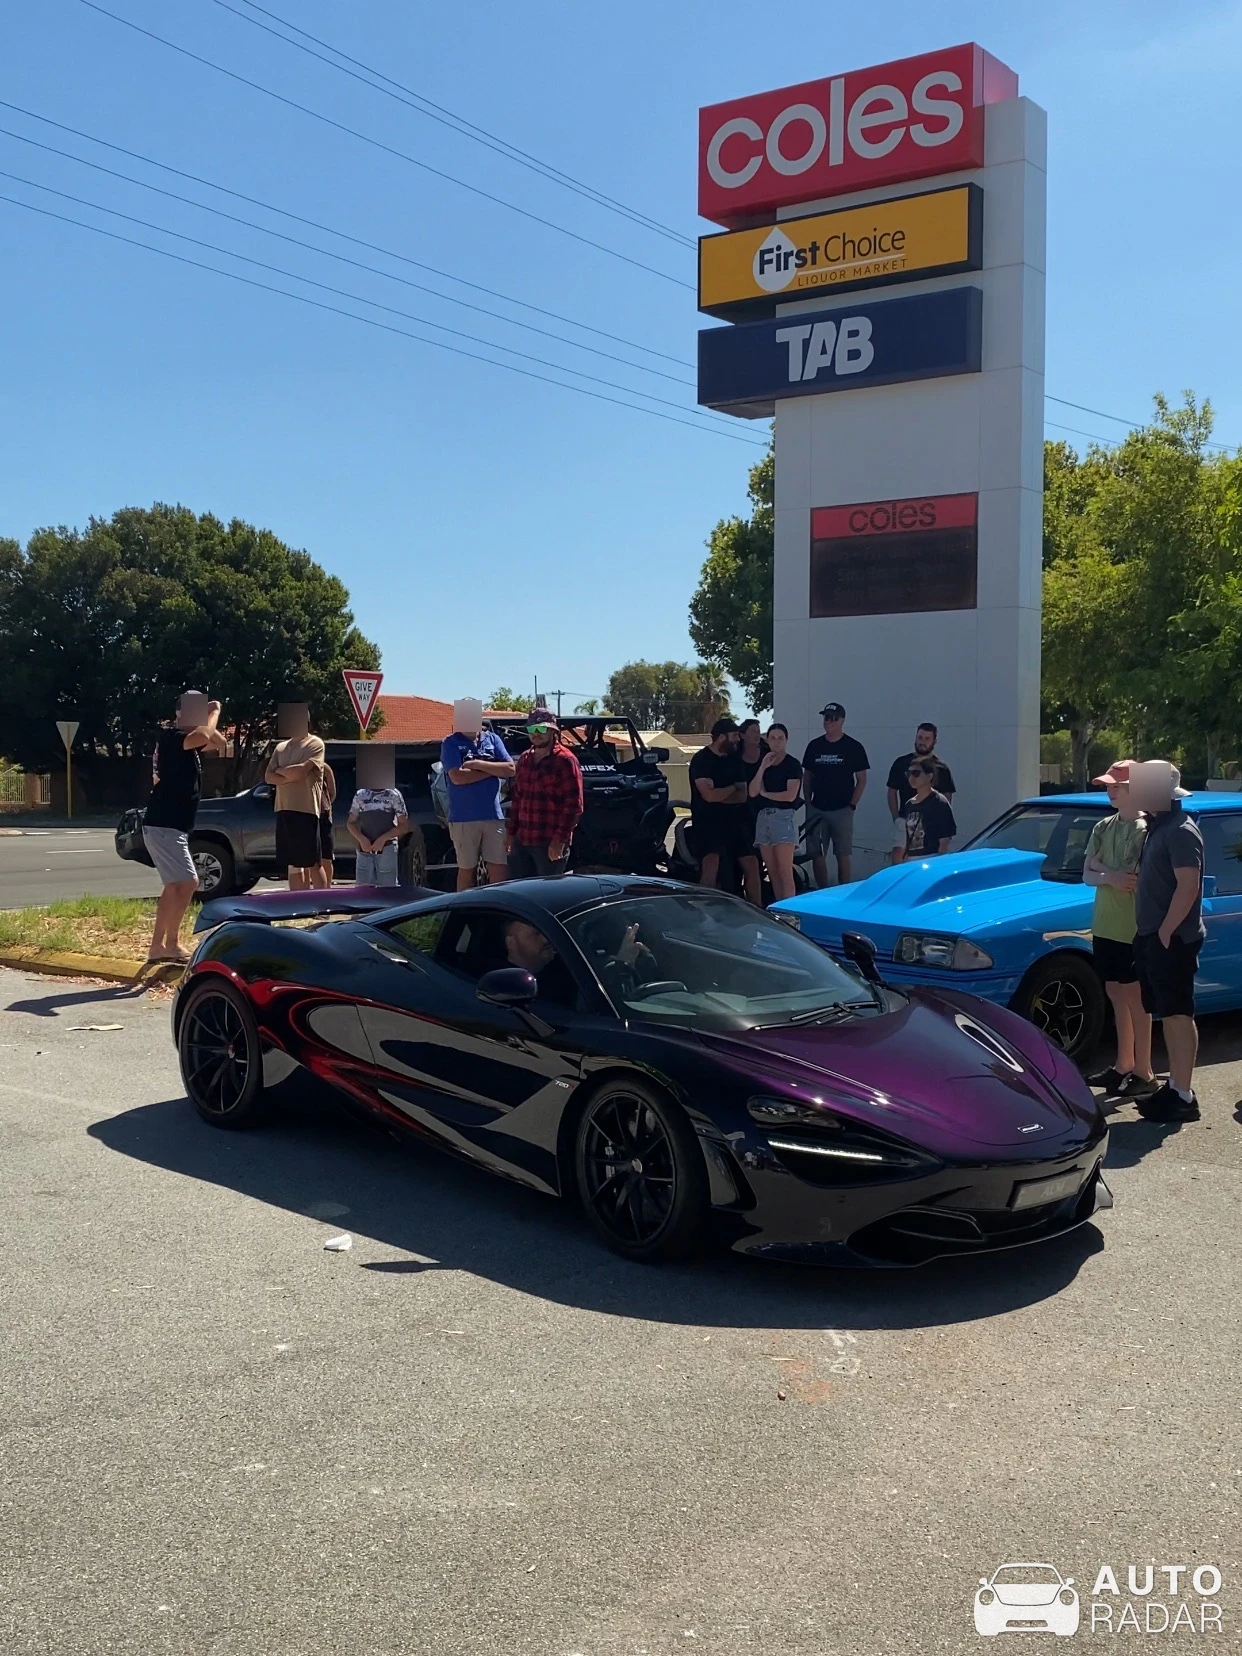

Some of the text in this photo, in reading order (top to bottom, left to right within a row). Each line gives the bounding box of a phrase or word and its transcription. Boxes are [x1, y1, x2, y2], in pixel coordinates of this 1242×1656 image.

[706, 70, 964, 189] coles
[758, 227, 906, 275] First Choice
[797, 258, 908, 287] LIQUOR MARKET
[775, 316, 874, 382] TAB
[849, 502, 937, 533] coles
[355, 682, 373, 692] GIVE
